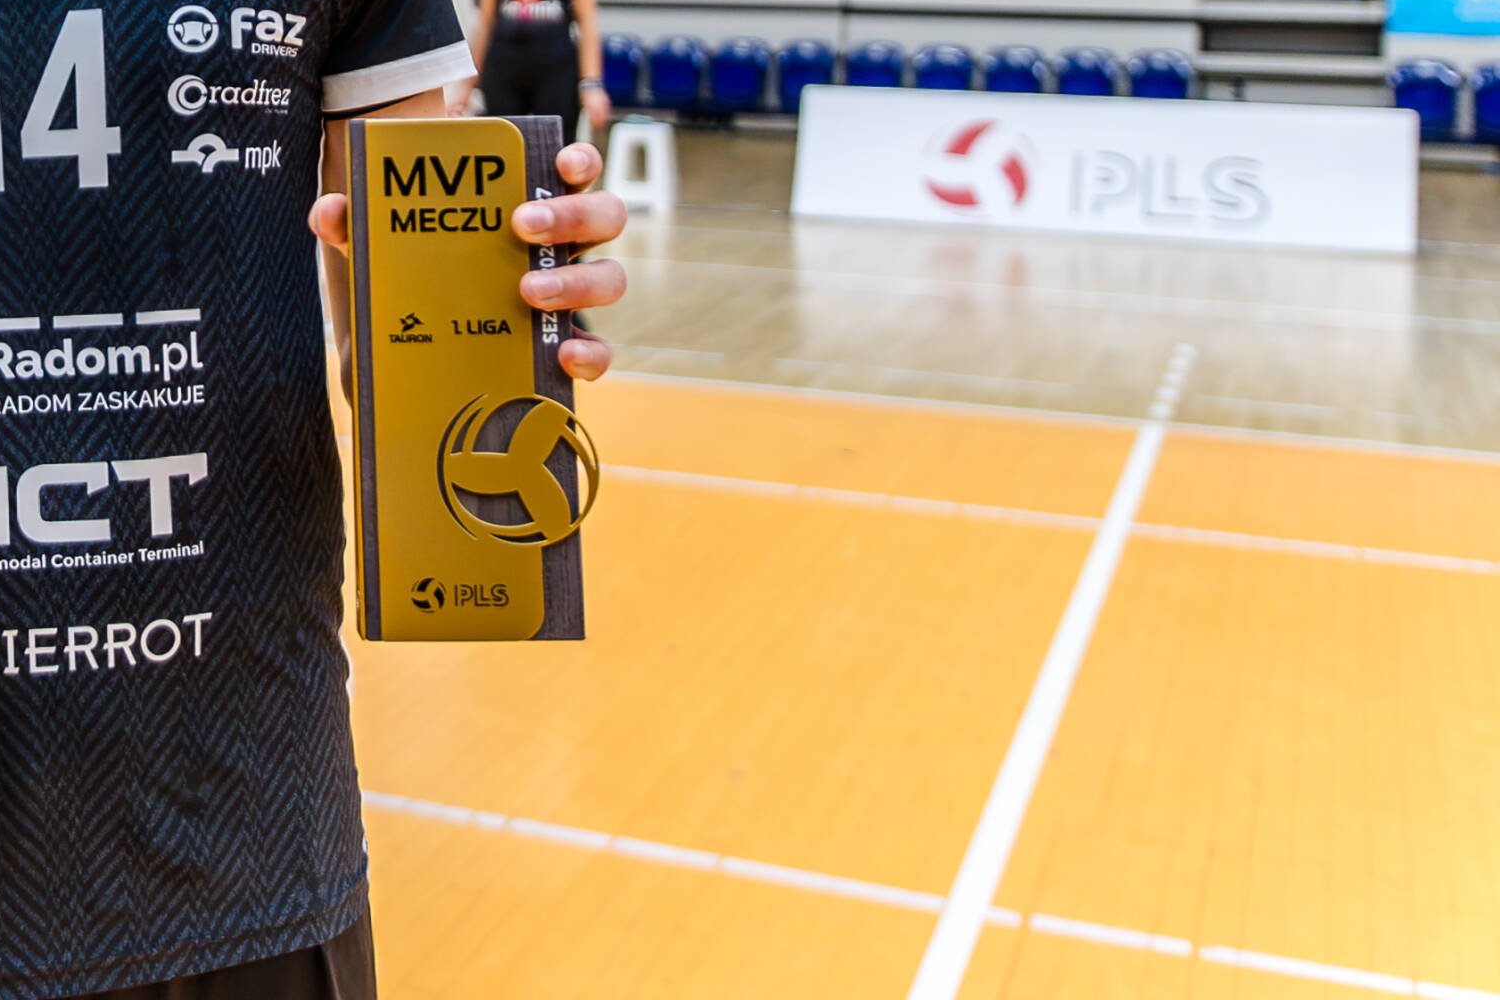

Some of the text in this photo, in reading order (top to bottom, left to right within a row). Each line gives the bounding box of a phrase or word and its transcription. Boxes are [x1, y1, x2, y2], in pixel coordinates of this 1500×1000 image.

[251, 42, 300, 58] DRIVERS
[208, 79, 292, 106] radfrez
[244, 139, 283, 177] mpk
[383, 154, 507, 198] MVP
[390, 206, 503, 234] MECZU
[388, 333, 434, 344] TAURON
[466, 319, 513, 336] LIGA
[77, 384, 205, 412] ZASKAKUJE
[50, 550, 135, 569] Container
[137, 540, 205, 563] Terminal
